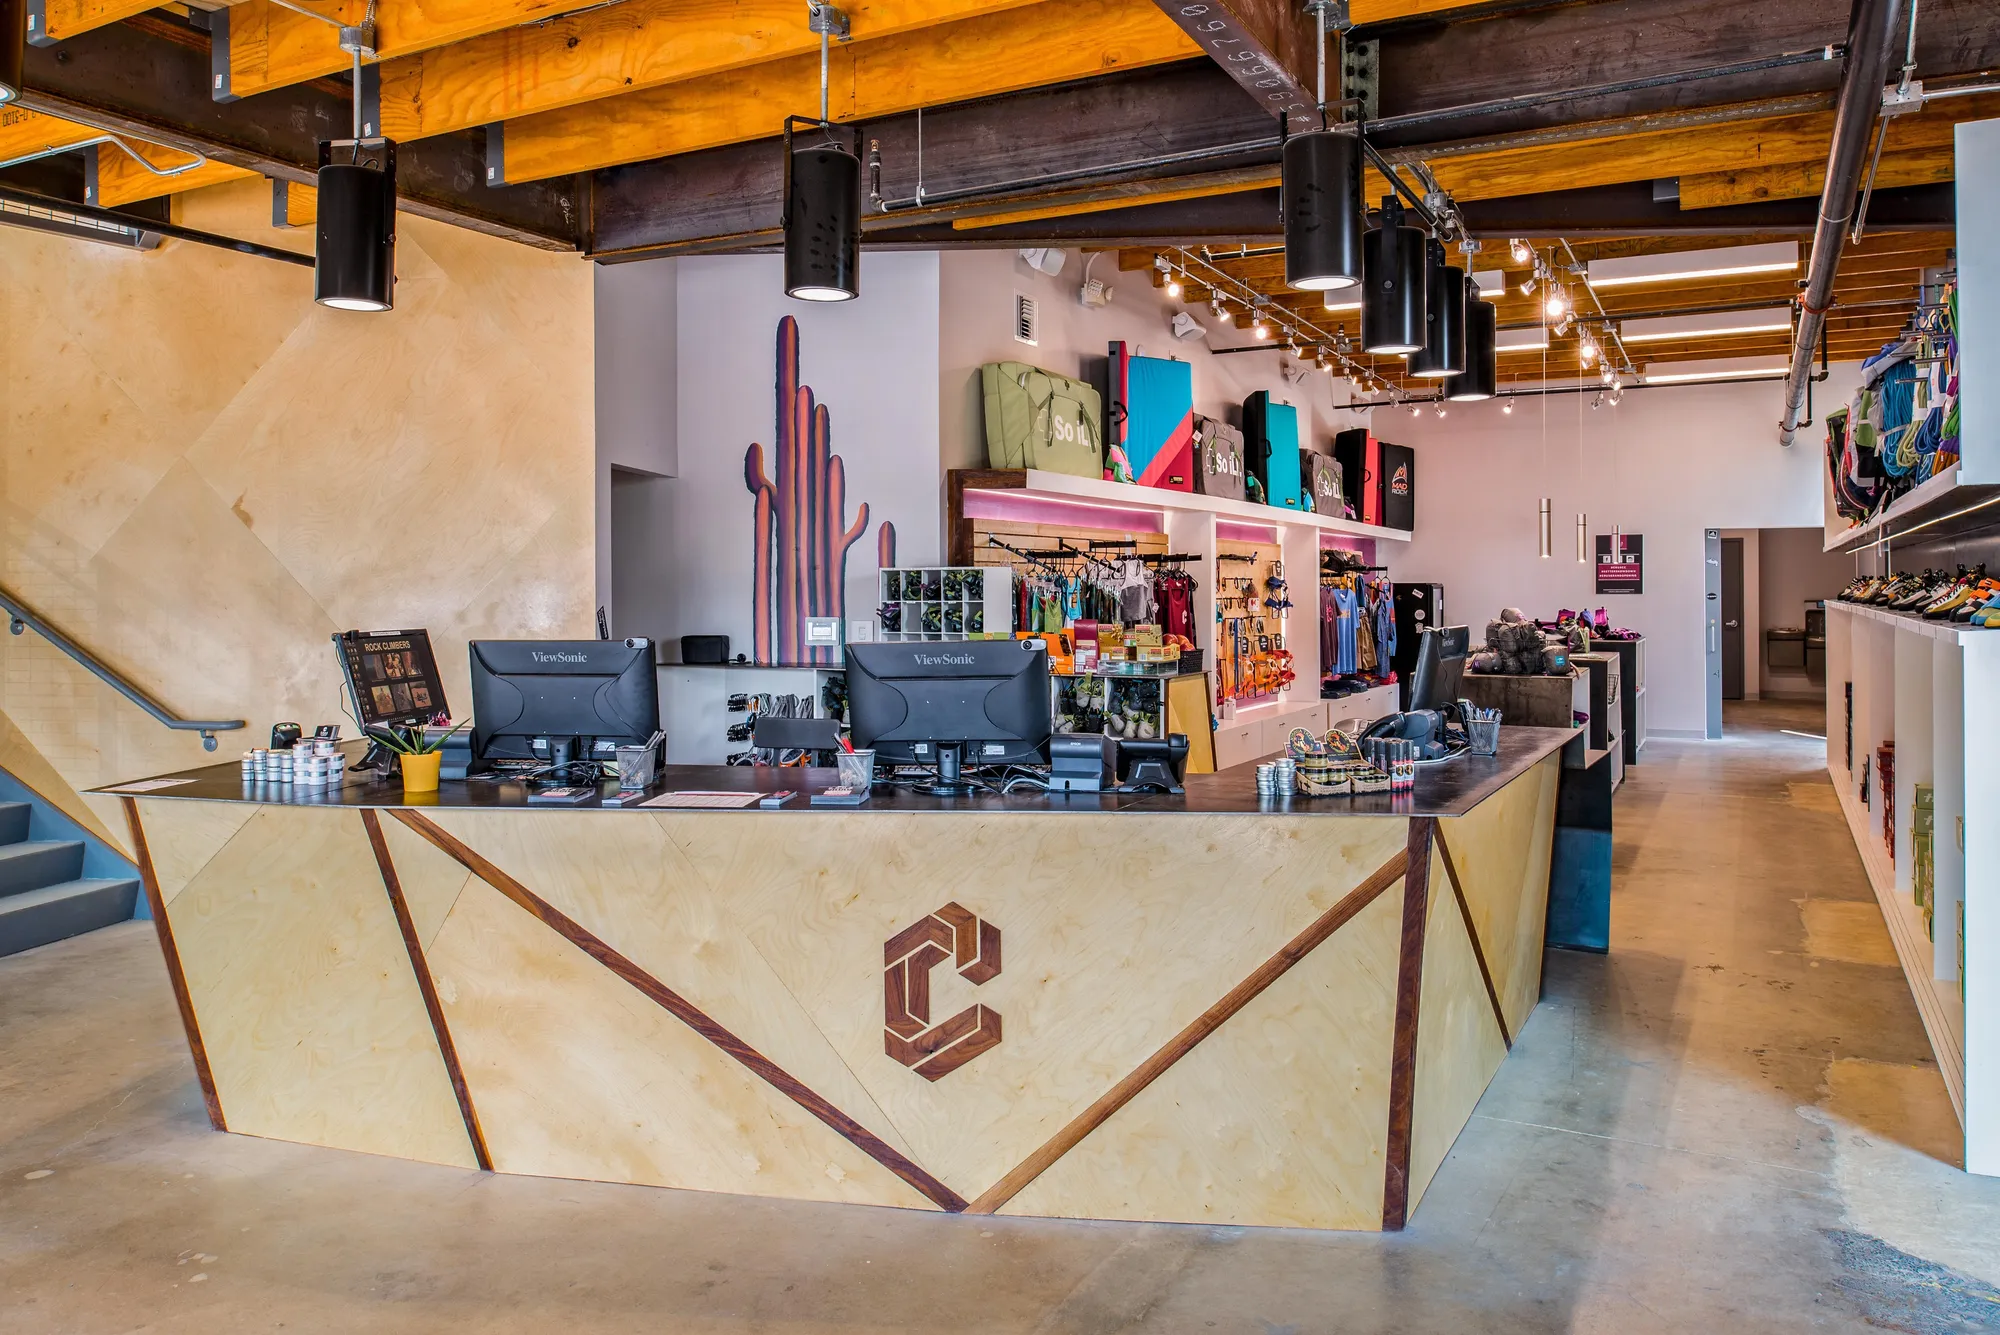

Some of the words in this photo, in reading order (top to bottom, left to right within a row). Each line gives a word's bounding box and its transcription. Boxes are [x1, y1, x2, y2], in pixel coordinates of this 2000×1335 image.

[1055, 414, 1074, 443] So
[1215, 452, 1228, 474] So
[1391, 482, 1408, 491] MAD
[1391, 487, 1409, 496] ROCK
[364, 641, 383, 652] ROCK
[382, 640, 412, 651] CLIMBERS
[531, 651, 588, 663] ViewSonic
[913, 653, 976, 665] ViewSonic
